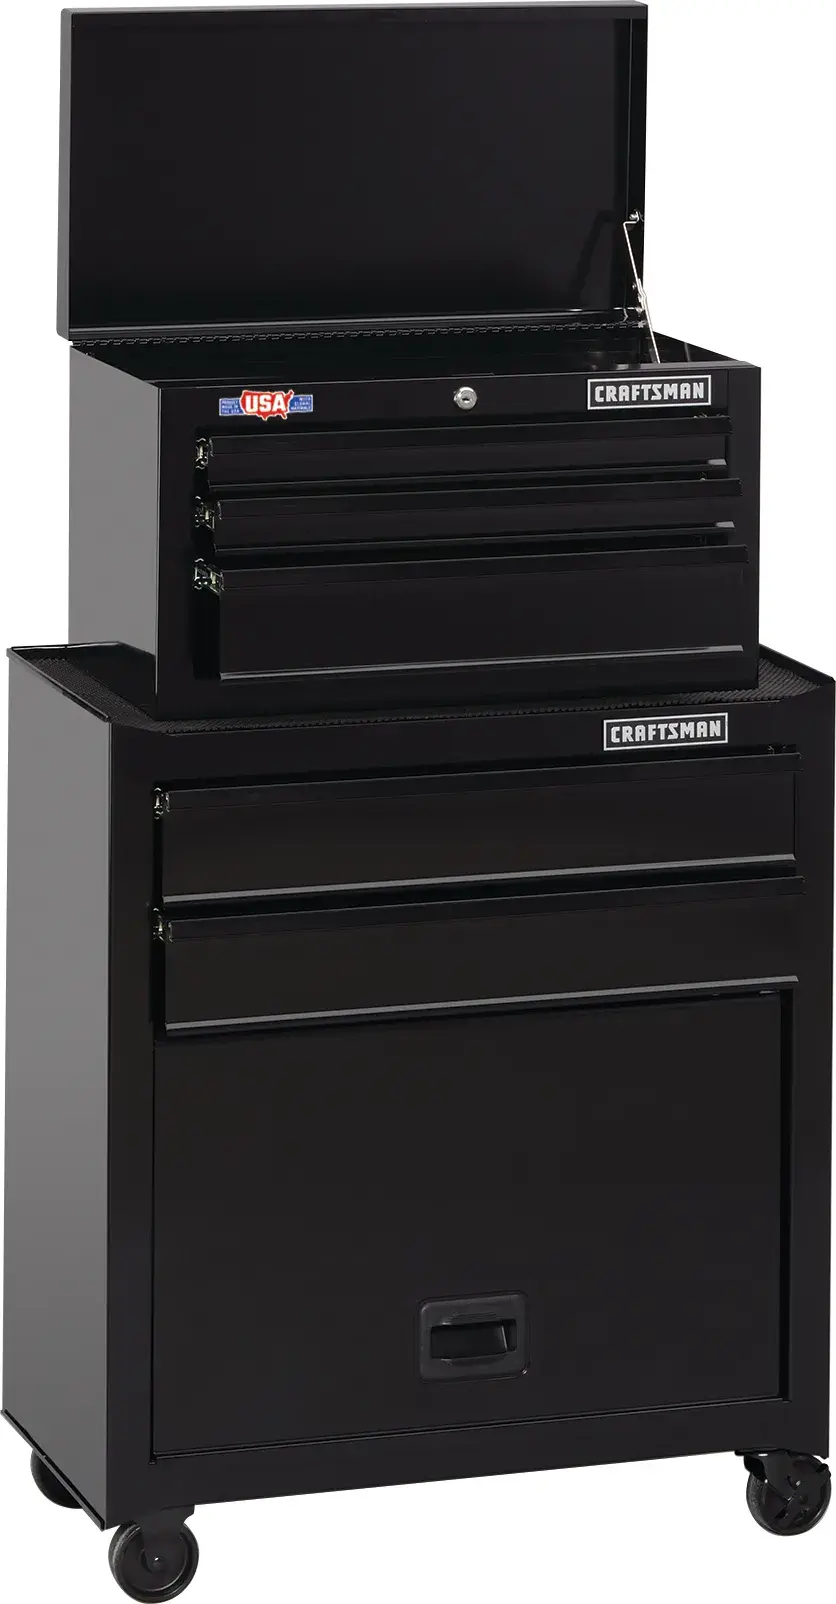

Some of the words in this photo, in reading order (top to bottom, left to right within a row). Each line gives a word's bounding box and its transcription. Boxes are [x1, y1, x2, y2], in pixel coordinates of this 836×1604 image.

[594, 382, 704, 402] CRAFTSMAN
[245, 394, 287, 412] USA
[611, 720, 721, 743] CRAFTSMAN
